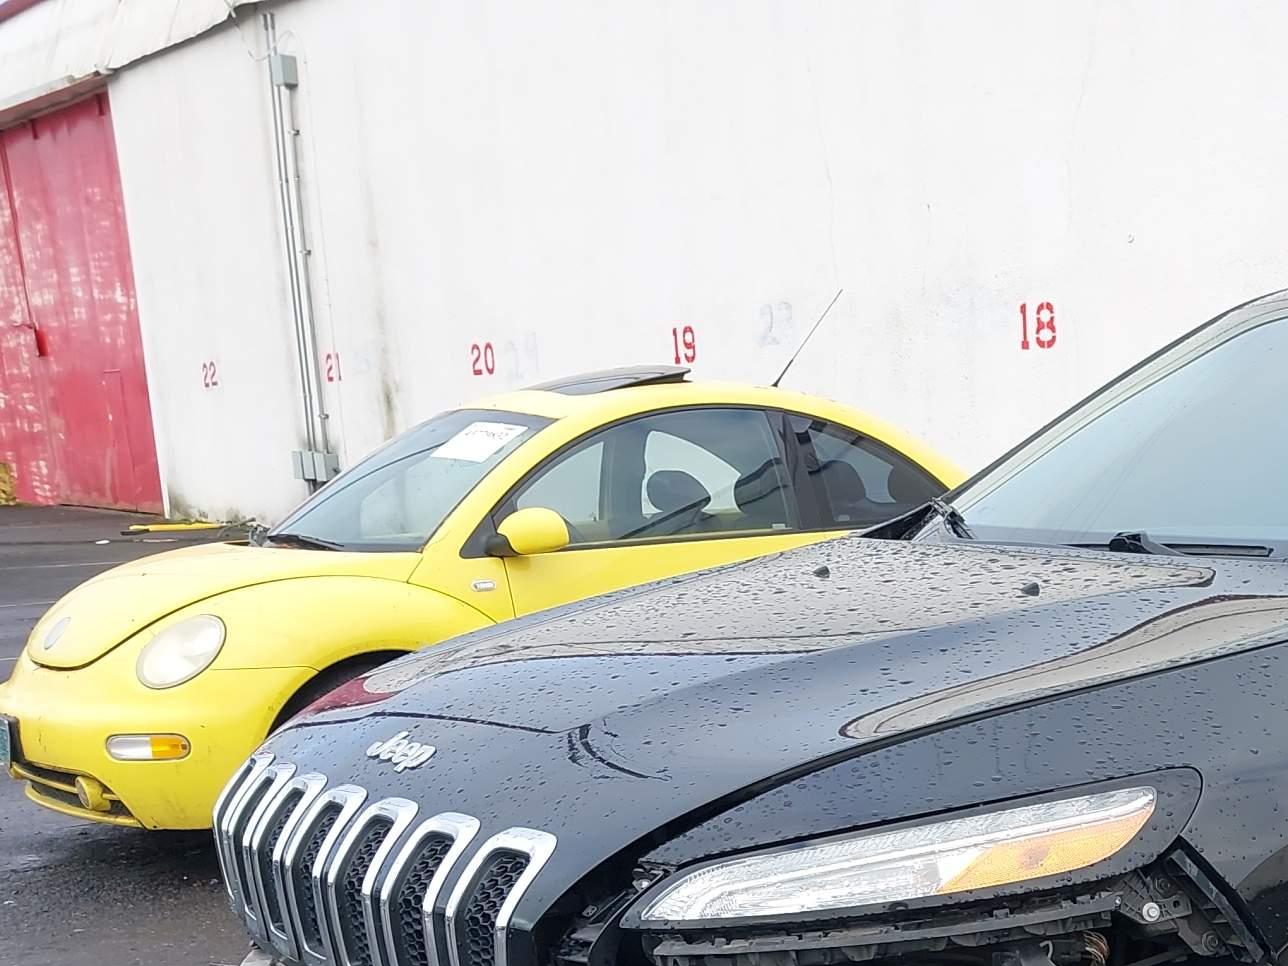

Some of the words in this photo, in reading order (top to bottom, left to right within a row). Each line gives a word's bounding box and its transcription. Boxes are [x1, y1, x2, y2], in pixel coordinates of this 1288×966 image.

[1020, 301, 1057, 350] 18
[470, 342, 495, 376] 20
[672, 325, 696, 365] 19
[201, 360, 218, 388] 22
[325, 352, 342, 383] 21
[366, 730, 437, 774] Jeep
